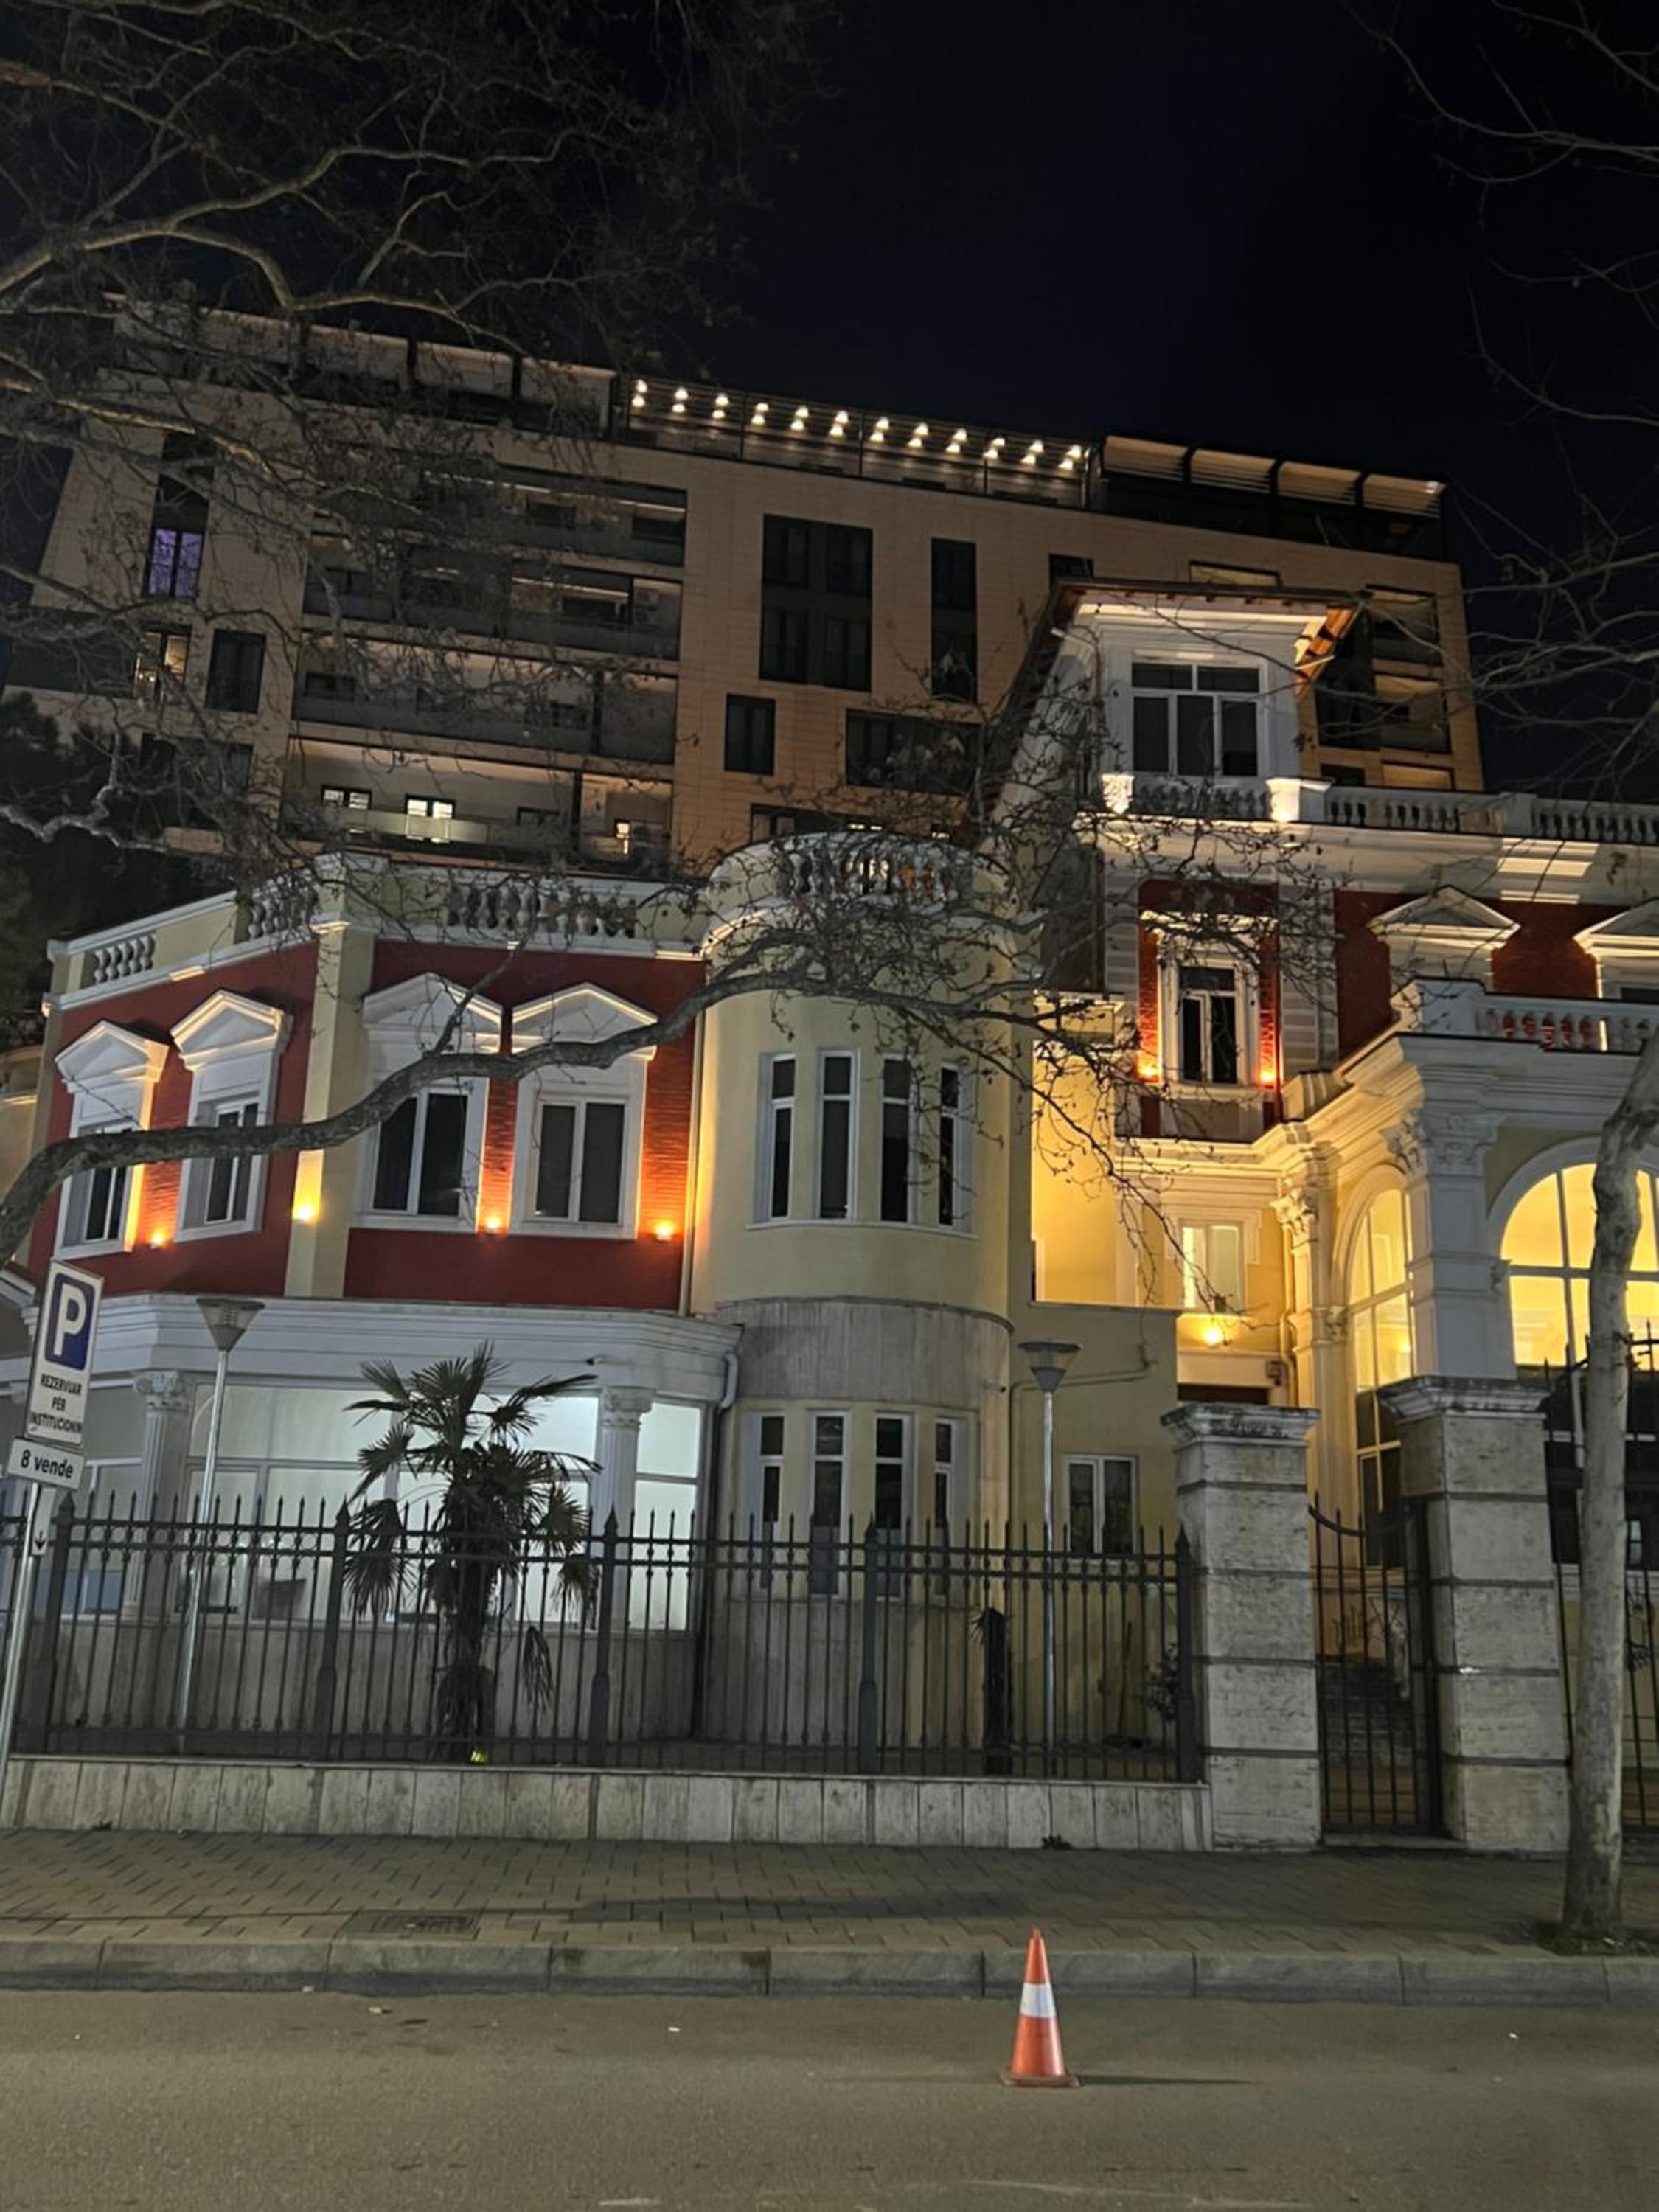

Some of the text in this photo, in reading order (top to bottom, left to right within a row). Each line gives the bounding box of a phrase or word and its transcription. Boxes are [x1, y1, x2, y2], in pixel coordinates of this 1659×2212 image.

[53, 1283, 87, 1357] P
[21, 1449, 73, 1478] 8 vende
